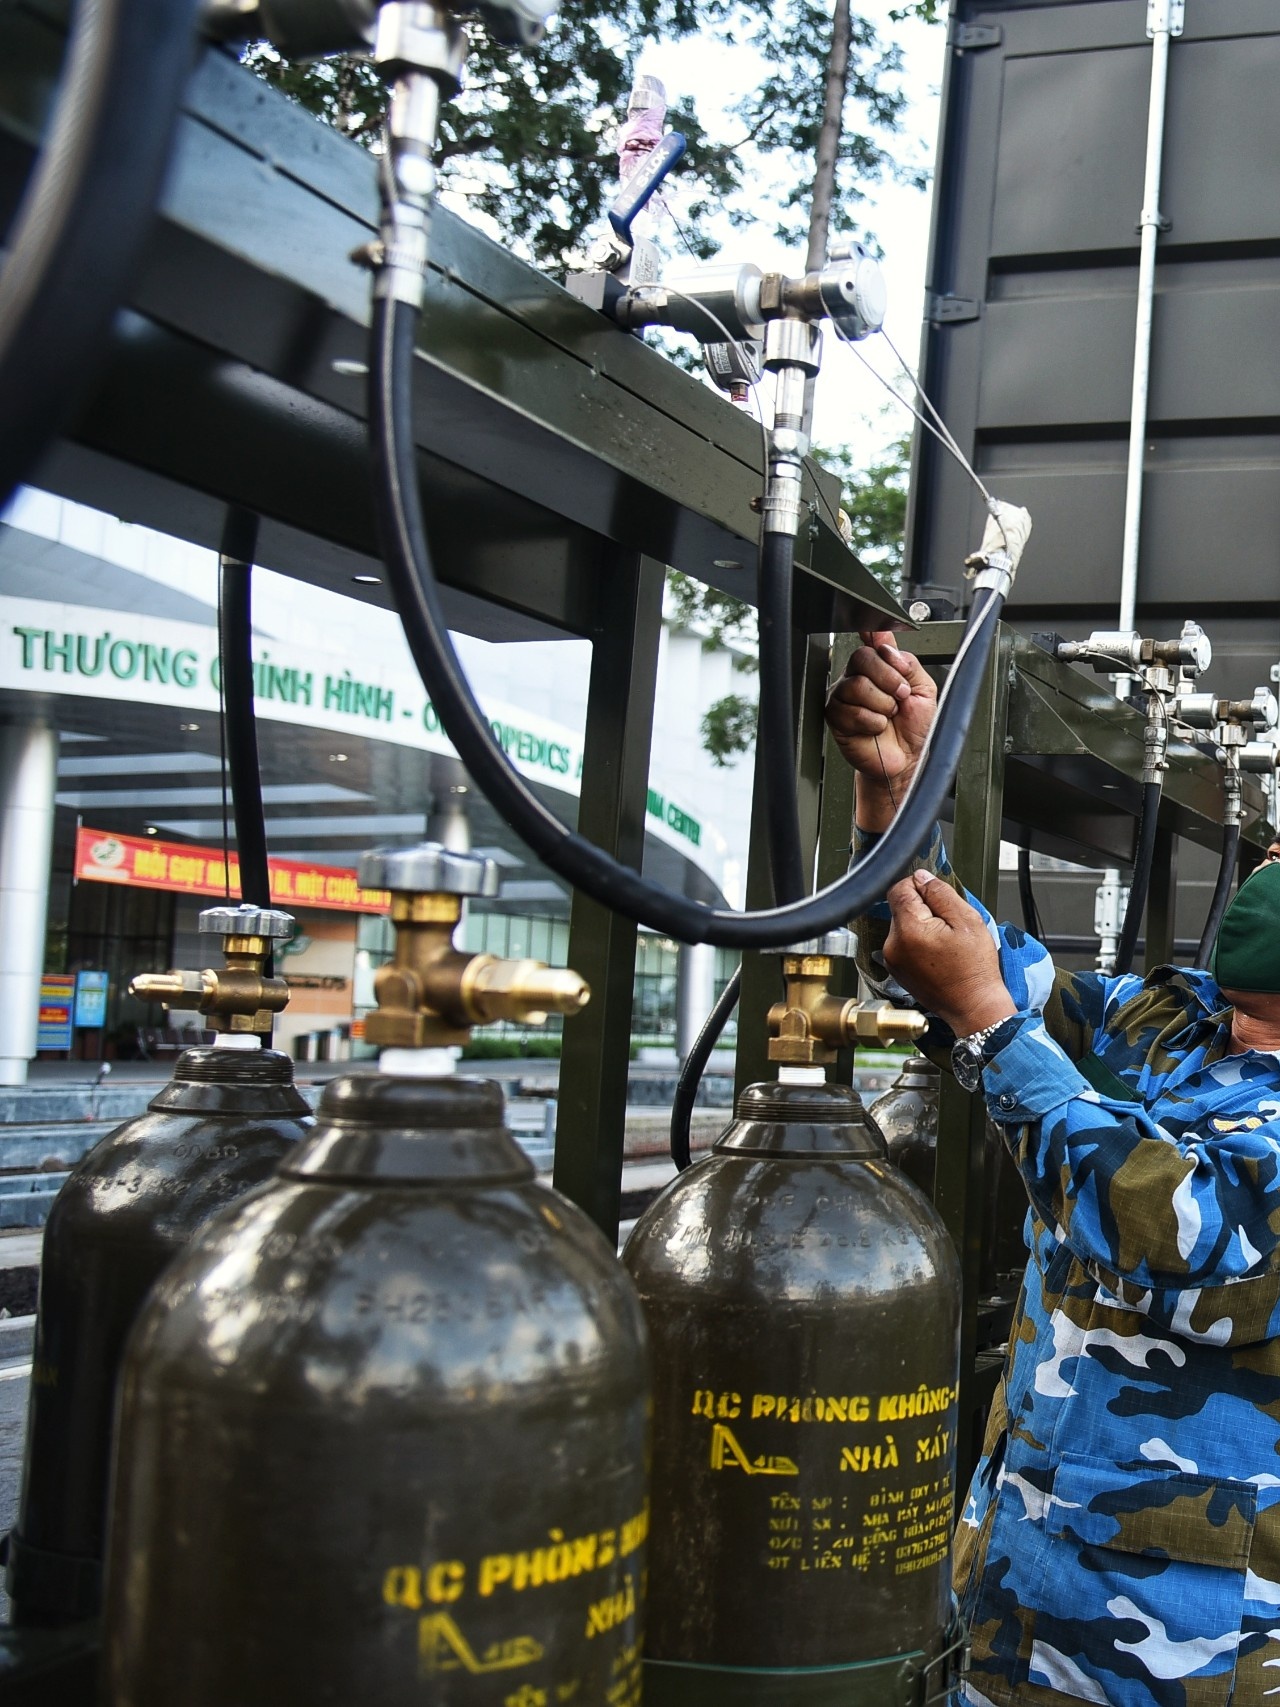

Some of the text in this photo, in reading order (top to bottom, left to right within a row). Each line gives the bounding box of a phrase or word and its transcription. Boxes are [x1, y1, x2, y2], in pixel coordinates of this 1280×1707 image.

[14, 626, 199, 688] THƯƠNG
[210, 651, 313, 706] CỈNH
[323, 669, 395, 722] HÌNH
[750, 1387, 870, 1423] PHÒNG
[840, 1434, 899, 1473] NHÀ
